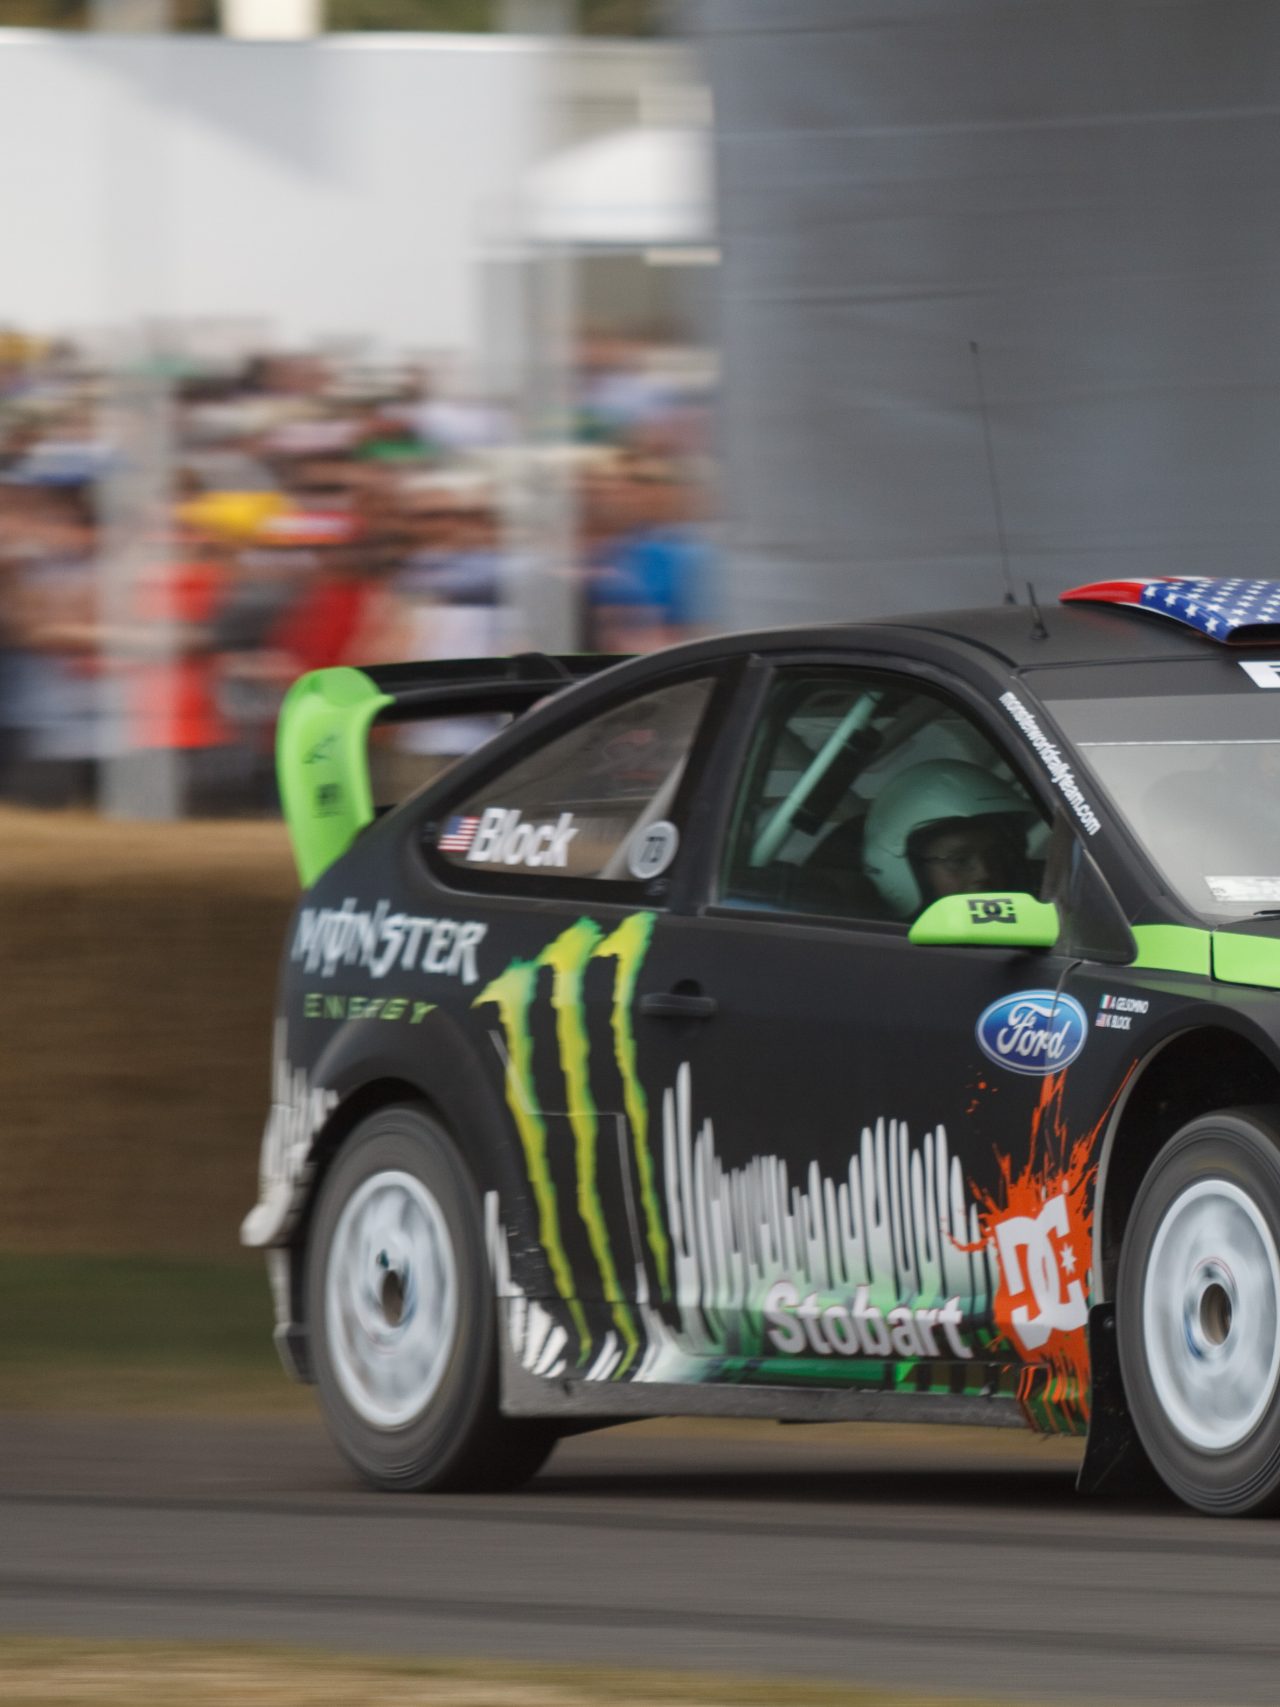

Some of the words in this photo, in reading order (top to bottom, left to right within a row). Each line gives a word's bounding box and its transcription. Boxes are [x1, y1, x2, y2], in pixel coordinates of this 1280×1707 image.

[465, 807, 579, 867] Block
[304, 993, 438, 1024] ENERGY
[997, 1002, 1072, 1059] Ford
[764, 1280, 974, 1358] Stobart
